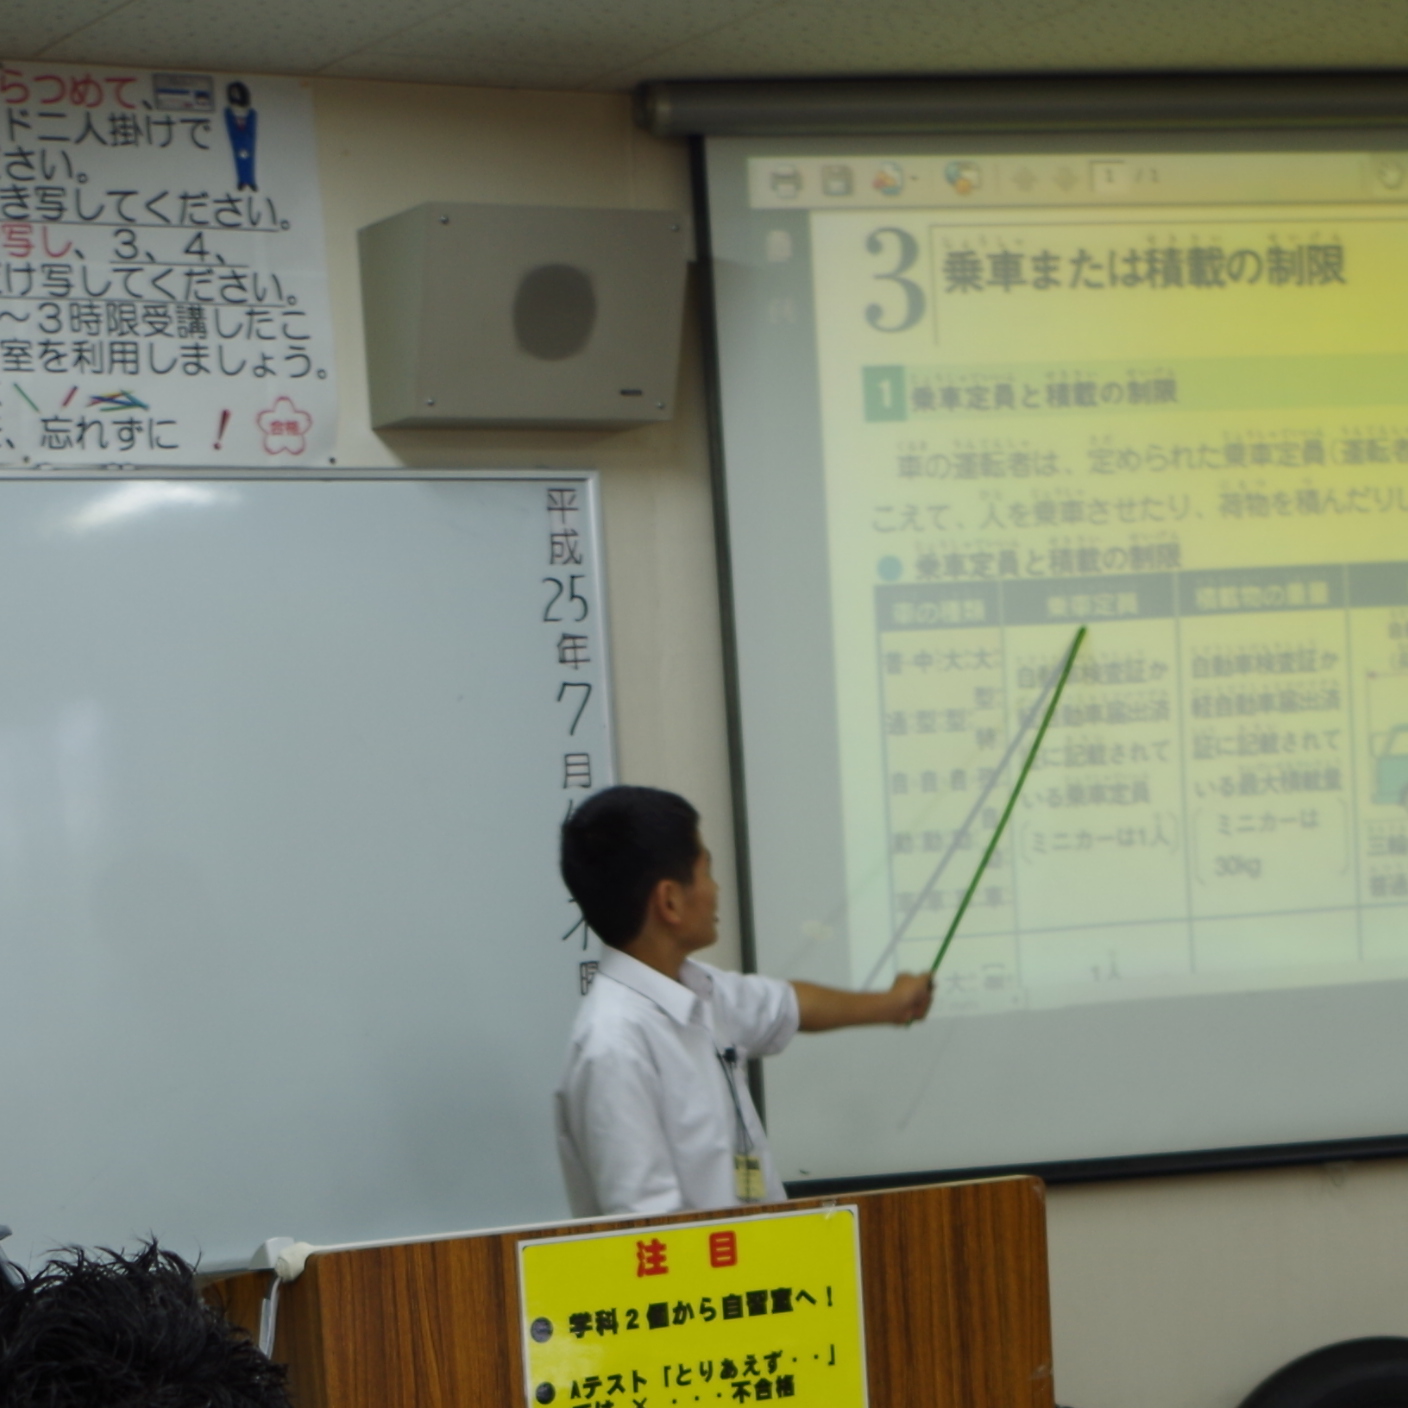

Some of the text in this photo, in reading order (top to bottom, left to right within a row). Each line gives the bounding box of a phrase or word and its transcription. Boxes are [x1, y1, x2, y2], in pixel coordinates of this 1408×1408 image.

[863, 226, 926, 333] 3
[942, 244, 1347, 294] 乗車または積載の制限
